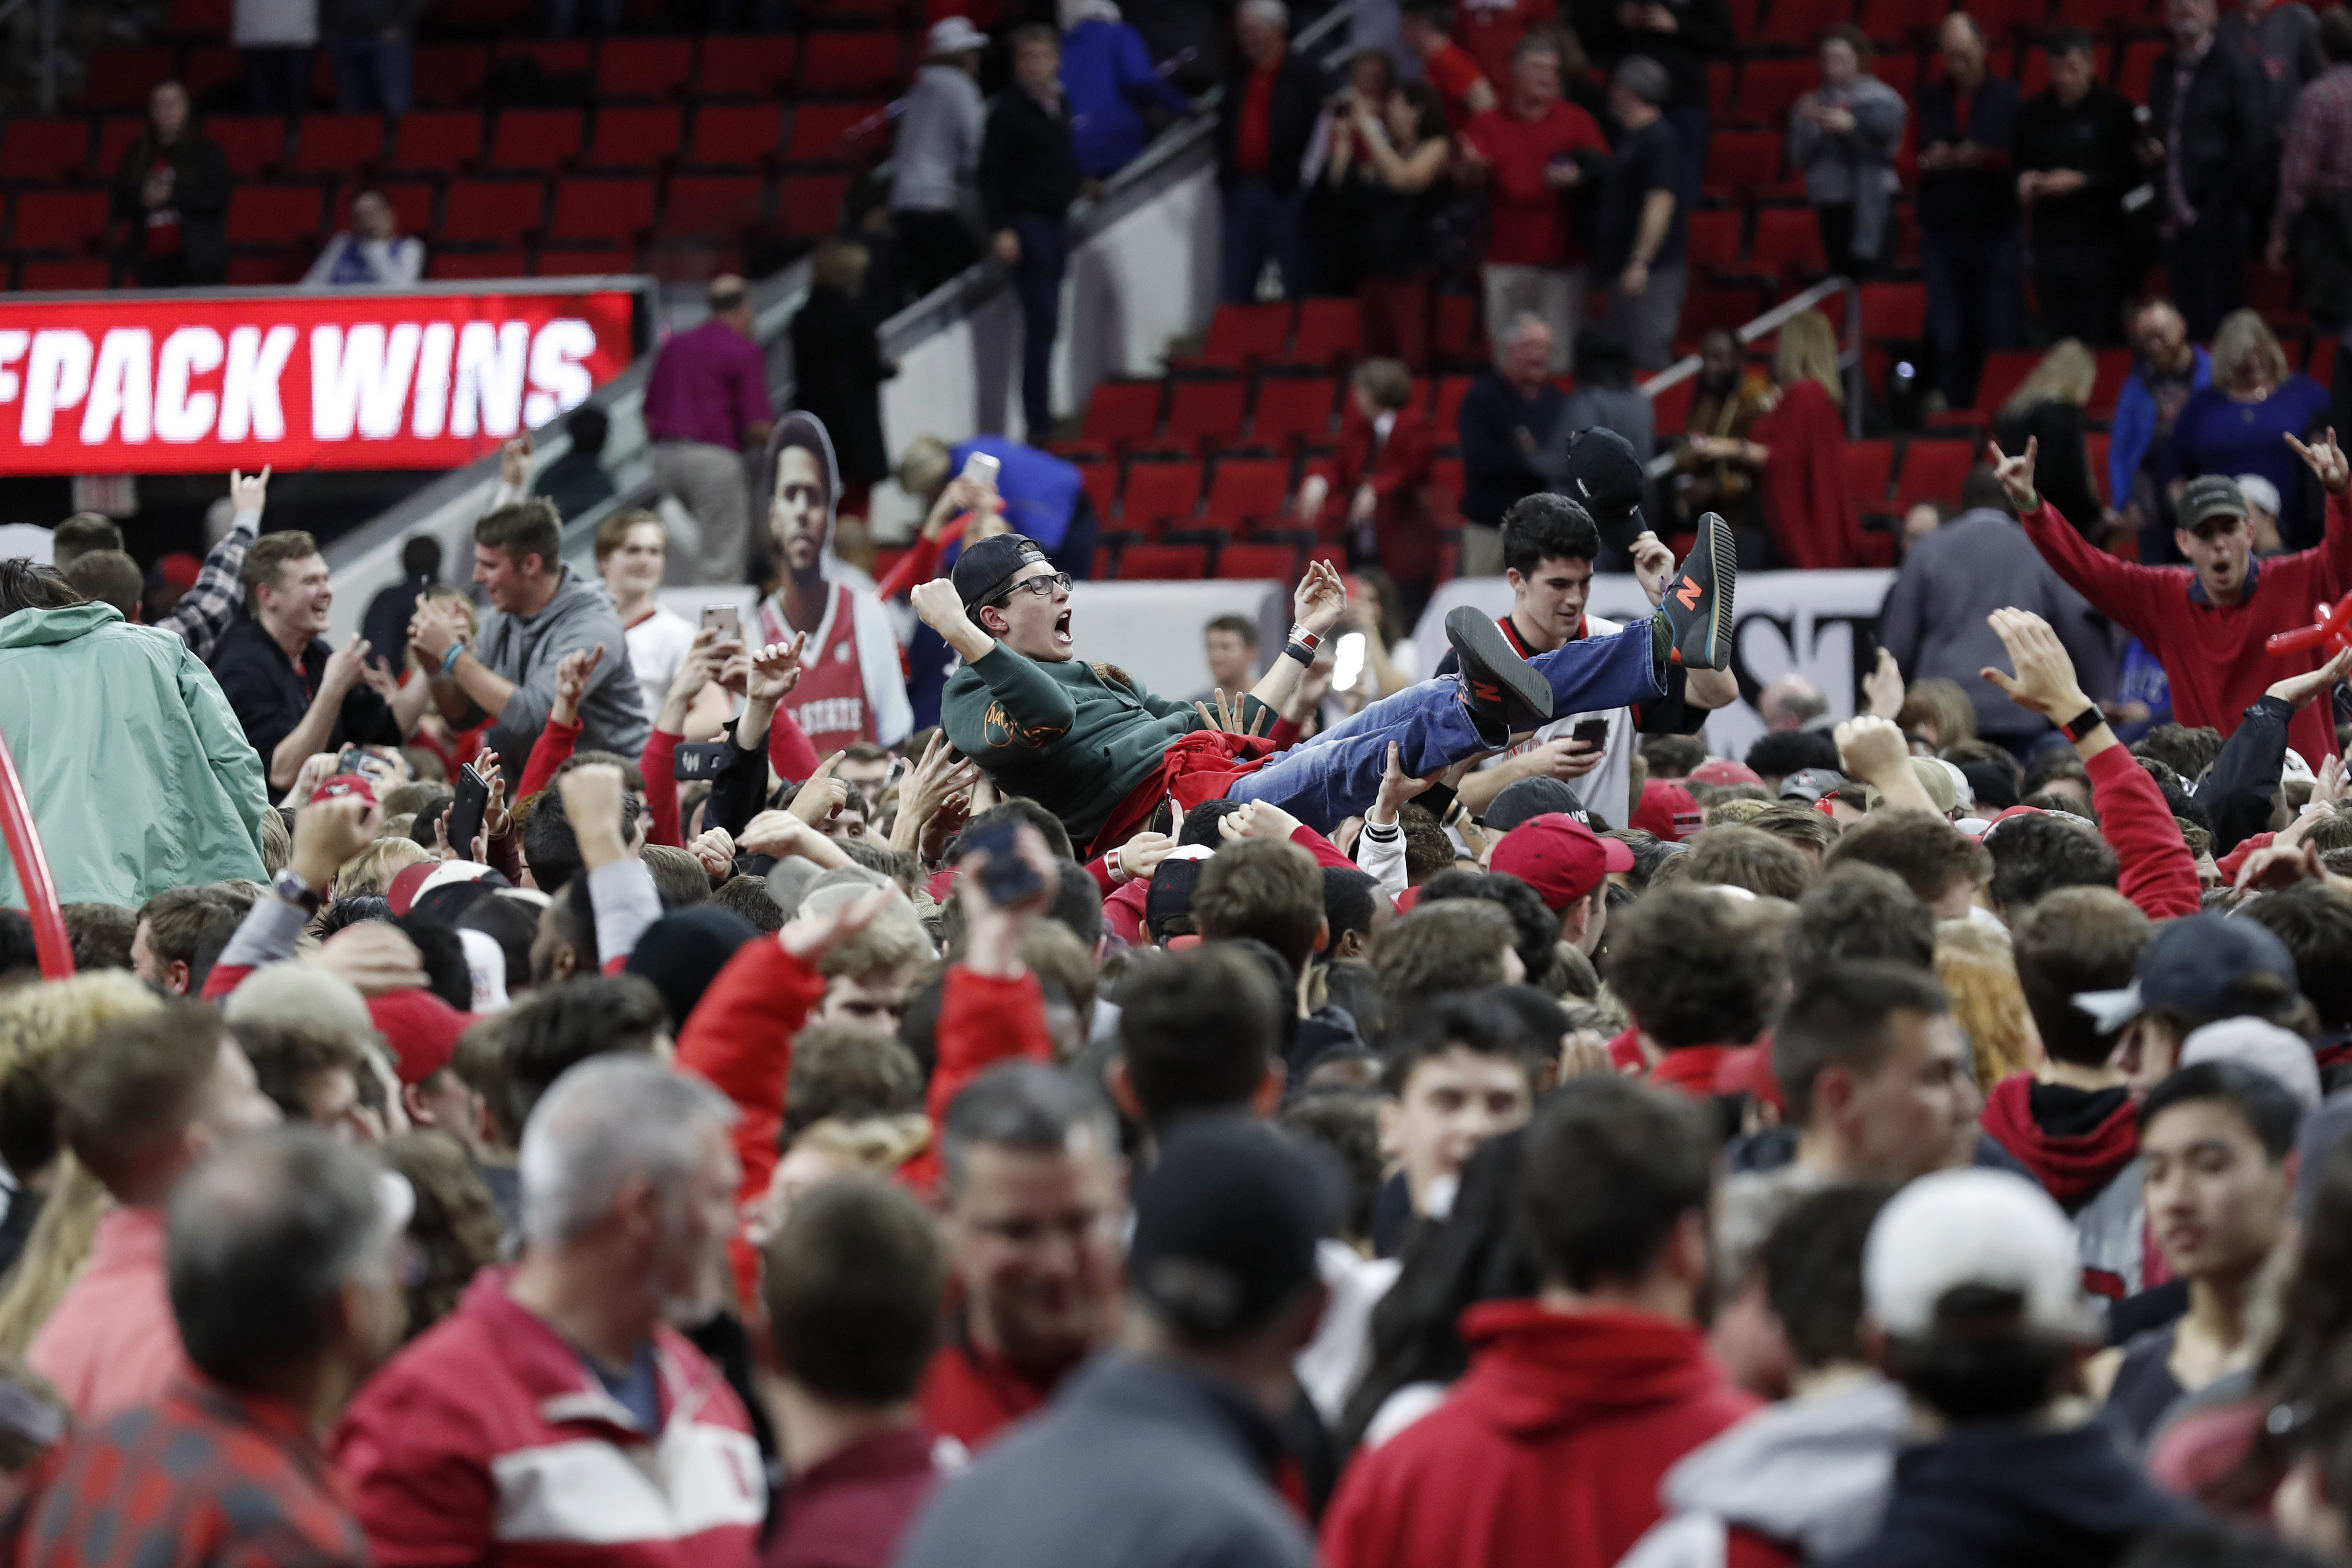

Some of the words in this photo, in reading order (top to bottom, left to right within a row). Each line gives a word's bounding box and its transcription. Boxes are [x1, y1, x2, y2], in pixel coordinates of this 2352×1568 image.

[310, 318, 596, 442] WINS
[1676, 575, 1703, 611] N
[1472, 680, 1502, 702] N
